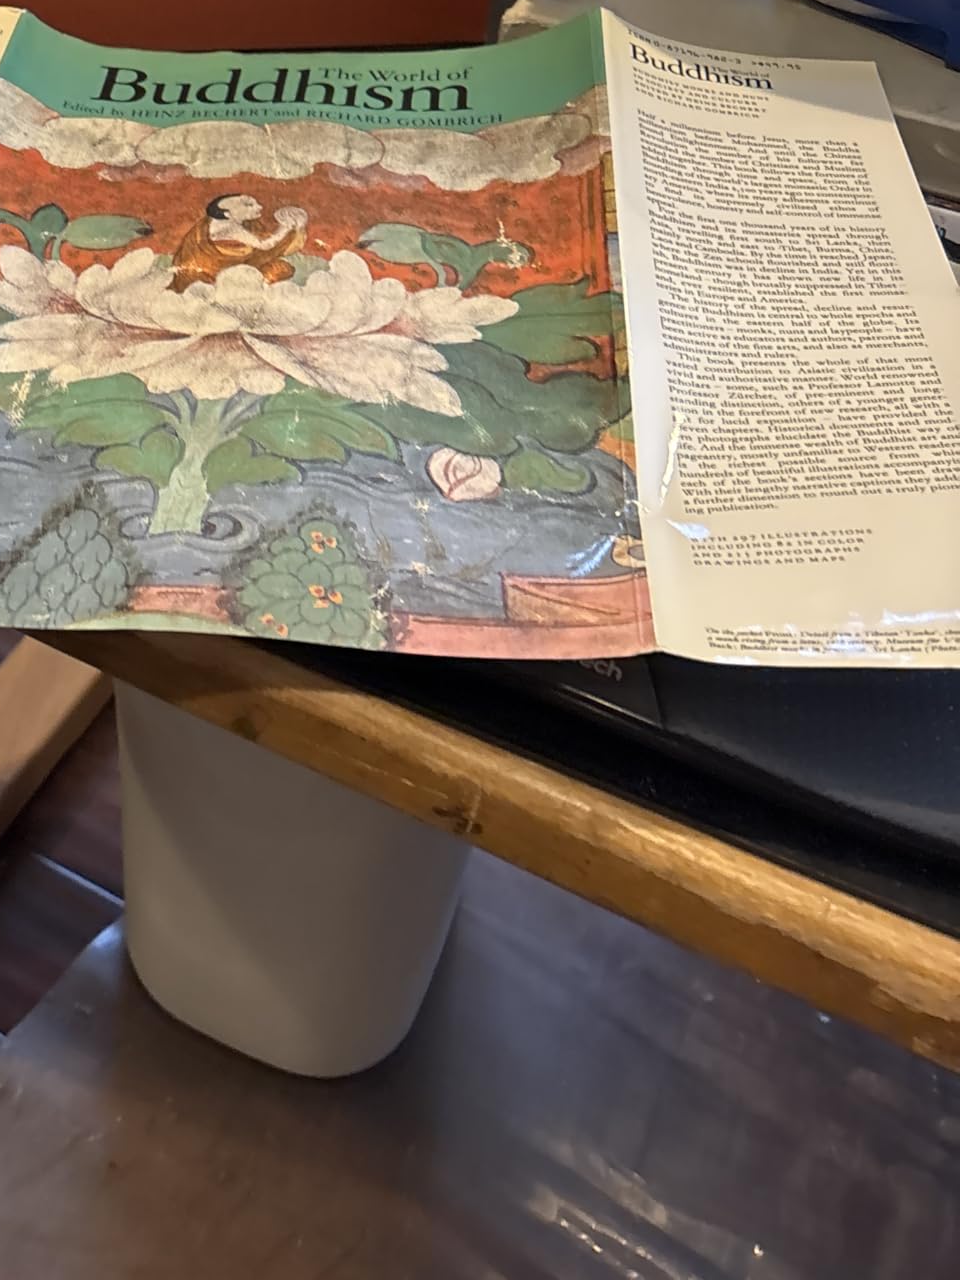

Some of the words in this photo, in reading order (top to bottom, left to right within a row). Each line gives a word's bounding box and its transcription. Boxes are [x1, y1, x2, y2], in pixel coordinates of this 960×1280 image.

[318, 67, 362, 81] The
[368, 68, 441, 82] World
[446, 66, 473, 81] of
[629, 42, 774, 90] Buddhism
[90, 65, 474, 112] Buddhism
[61, 101, 105, 115] Edited
[111, 107, 127, 117] by
[131, 109, 186, 118] HEINZ
[191, 108, 272, 118] BECHERT
[273, 109, 300, 118] and
[305, 110, 390, 124] RICHARD
[396, 113, 503, 126] GOMBRICH
[670, 122, 721, 135] millennium
[726, 131, 756, 140] before
[762, 135, 789, 144] Jesus,
[699, 154, 735, 163] number
[752, 160, 799, 169] Christians
[824, 165, 866, 173] Muslims
[676, 351, 701, 362] This
[706, 356, 734, 365] book
[741, 360, 786, 368] presents
[816, 358, 851, 366] whole
[856, 357, 868, 365] of
[669, 385, 720, 399] Professor
[728, 391, 777, 400] Zürcher,
[805, 390, 876, 400] pre-eminent
[677, 452, 737, 461] pageantry,
[740, 452, 779, 460] mostly
[783, 448, 844, 458] unfamiliar
[864, 445, 915, 453] Western
[685, 507, 705, 515] ing
[707, 504, 779, 514] publication.
[760, 528, 873, 540] ILLUSTRATIONS
[690, 541, 772, 550] INCLUDING
[817, 537, 866, 546] COLOR
[755, 547, 861, 557] PHOTOGRAPHS
[693, 558, 771, 566] DRAWINGS
[809, 555, 846, 563] MAPS
